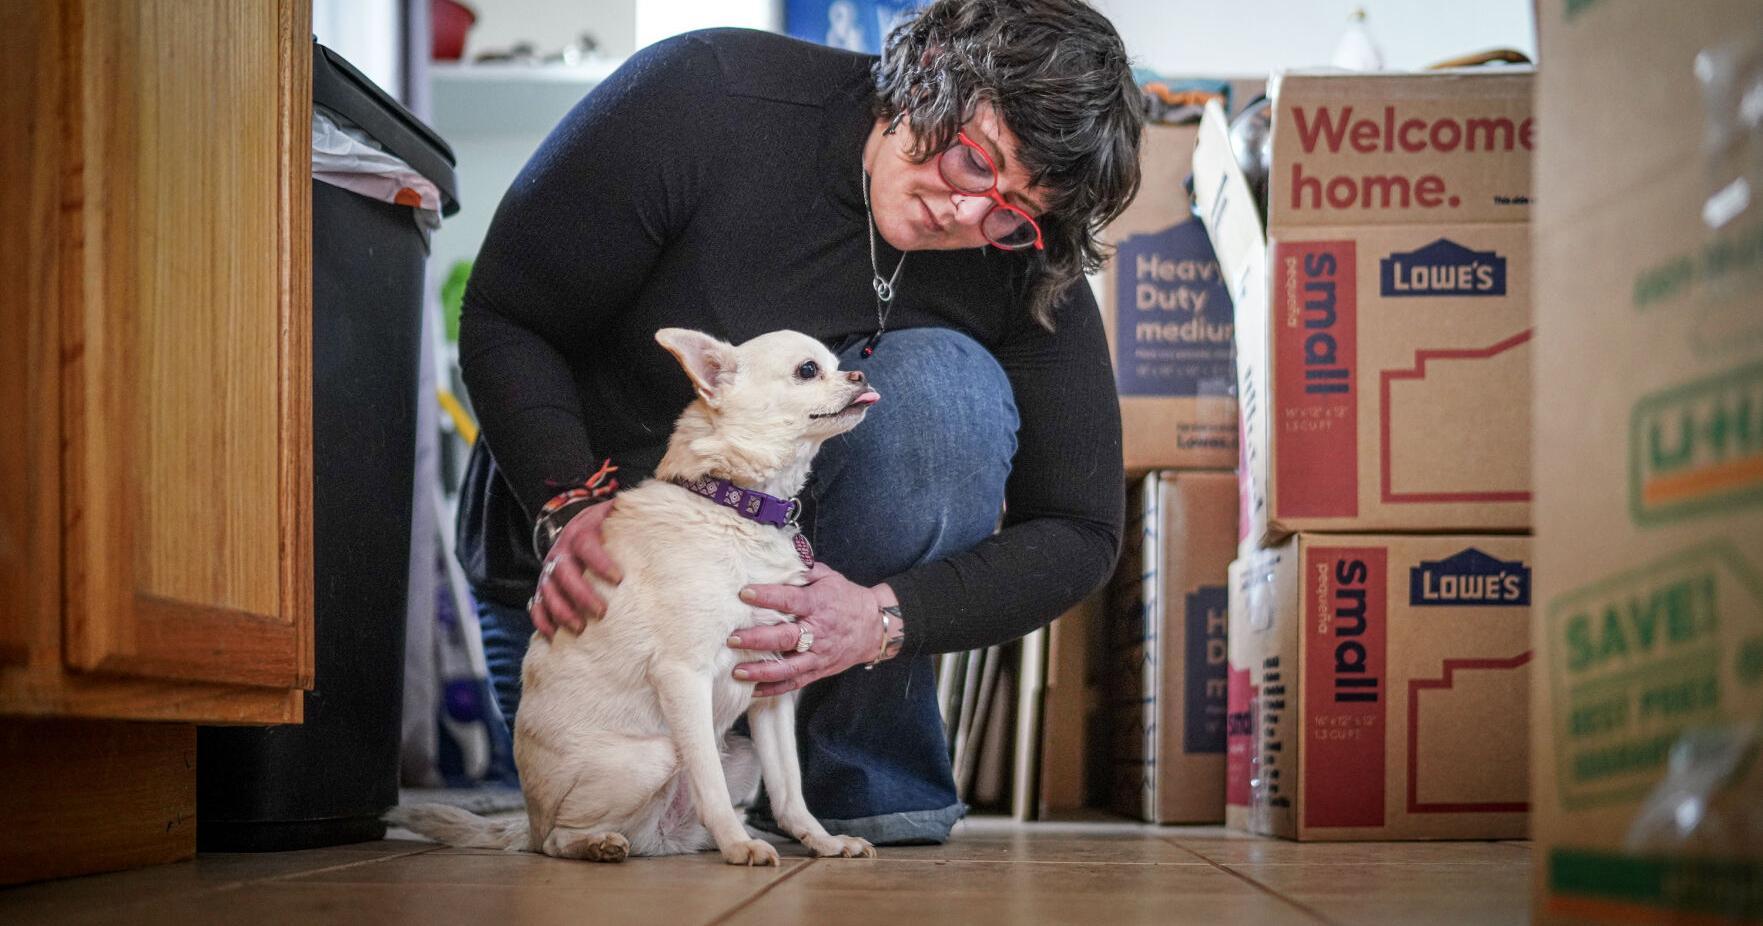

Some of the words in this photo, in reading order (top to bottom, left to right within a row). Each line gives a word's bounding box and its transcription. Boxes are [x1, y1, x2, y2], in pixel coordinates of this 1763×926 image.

[1291, 162, 1461, 209] home.
[1136, 283, 1207, 316] Duty
[1303, 251, 1350, 394] small
[1315, 562, 1331, 634] pequeña
[1335, 559, 1379, 703] small
